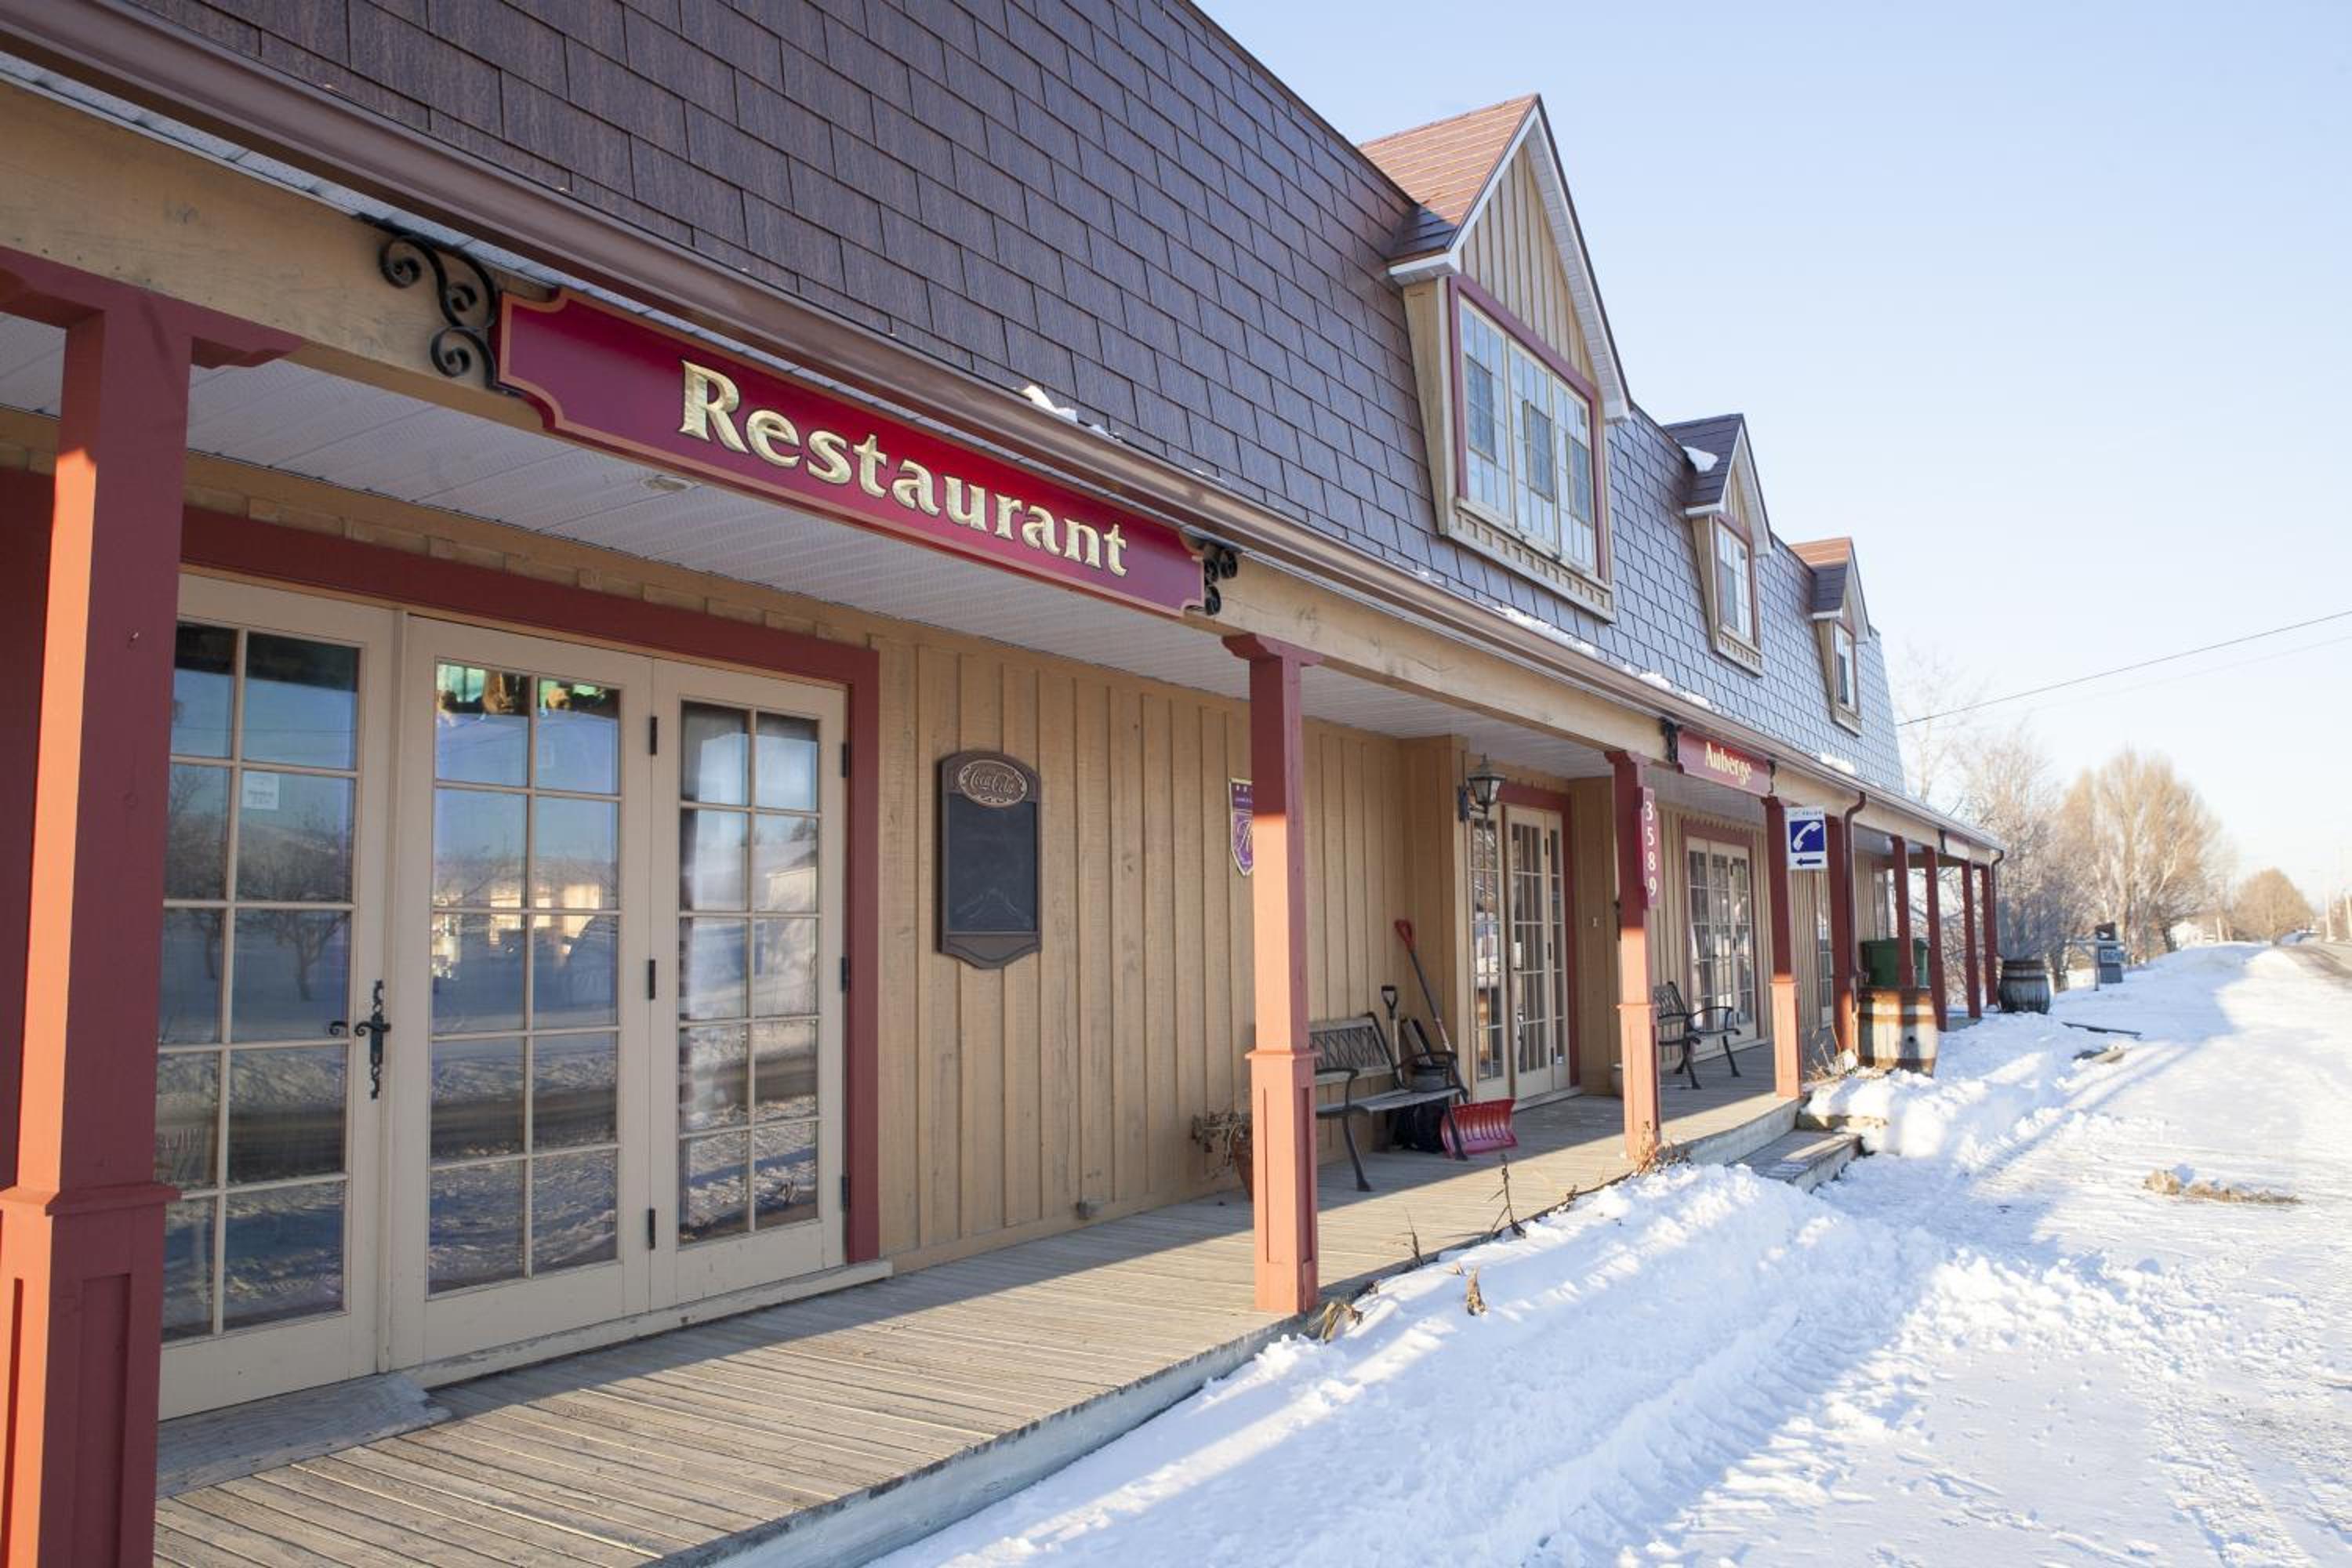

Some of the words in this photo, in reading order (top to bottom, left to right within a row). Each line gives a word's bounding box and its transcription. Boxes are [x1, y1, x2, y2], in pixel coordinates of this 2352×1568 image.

[679, 360, 1127, 576] Restaurant
[1705, 741, 1752, 785] Auberge
[1646, 801, 1657, 896] 3589
